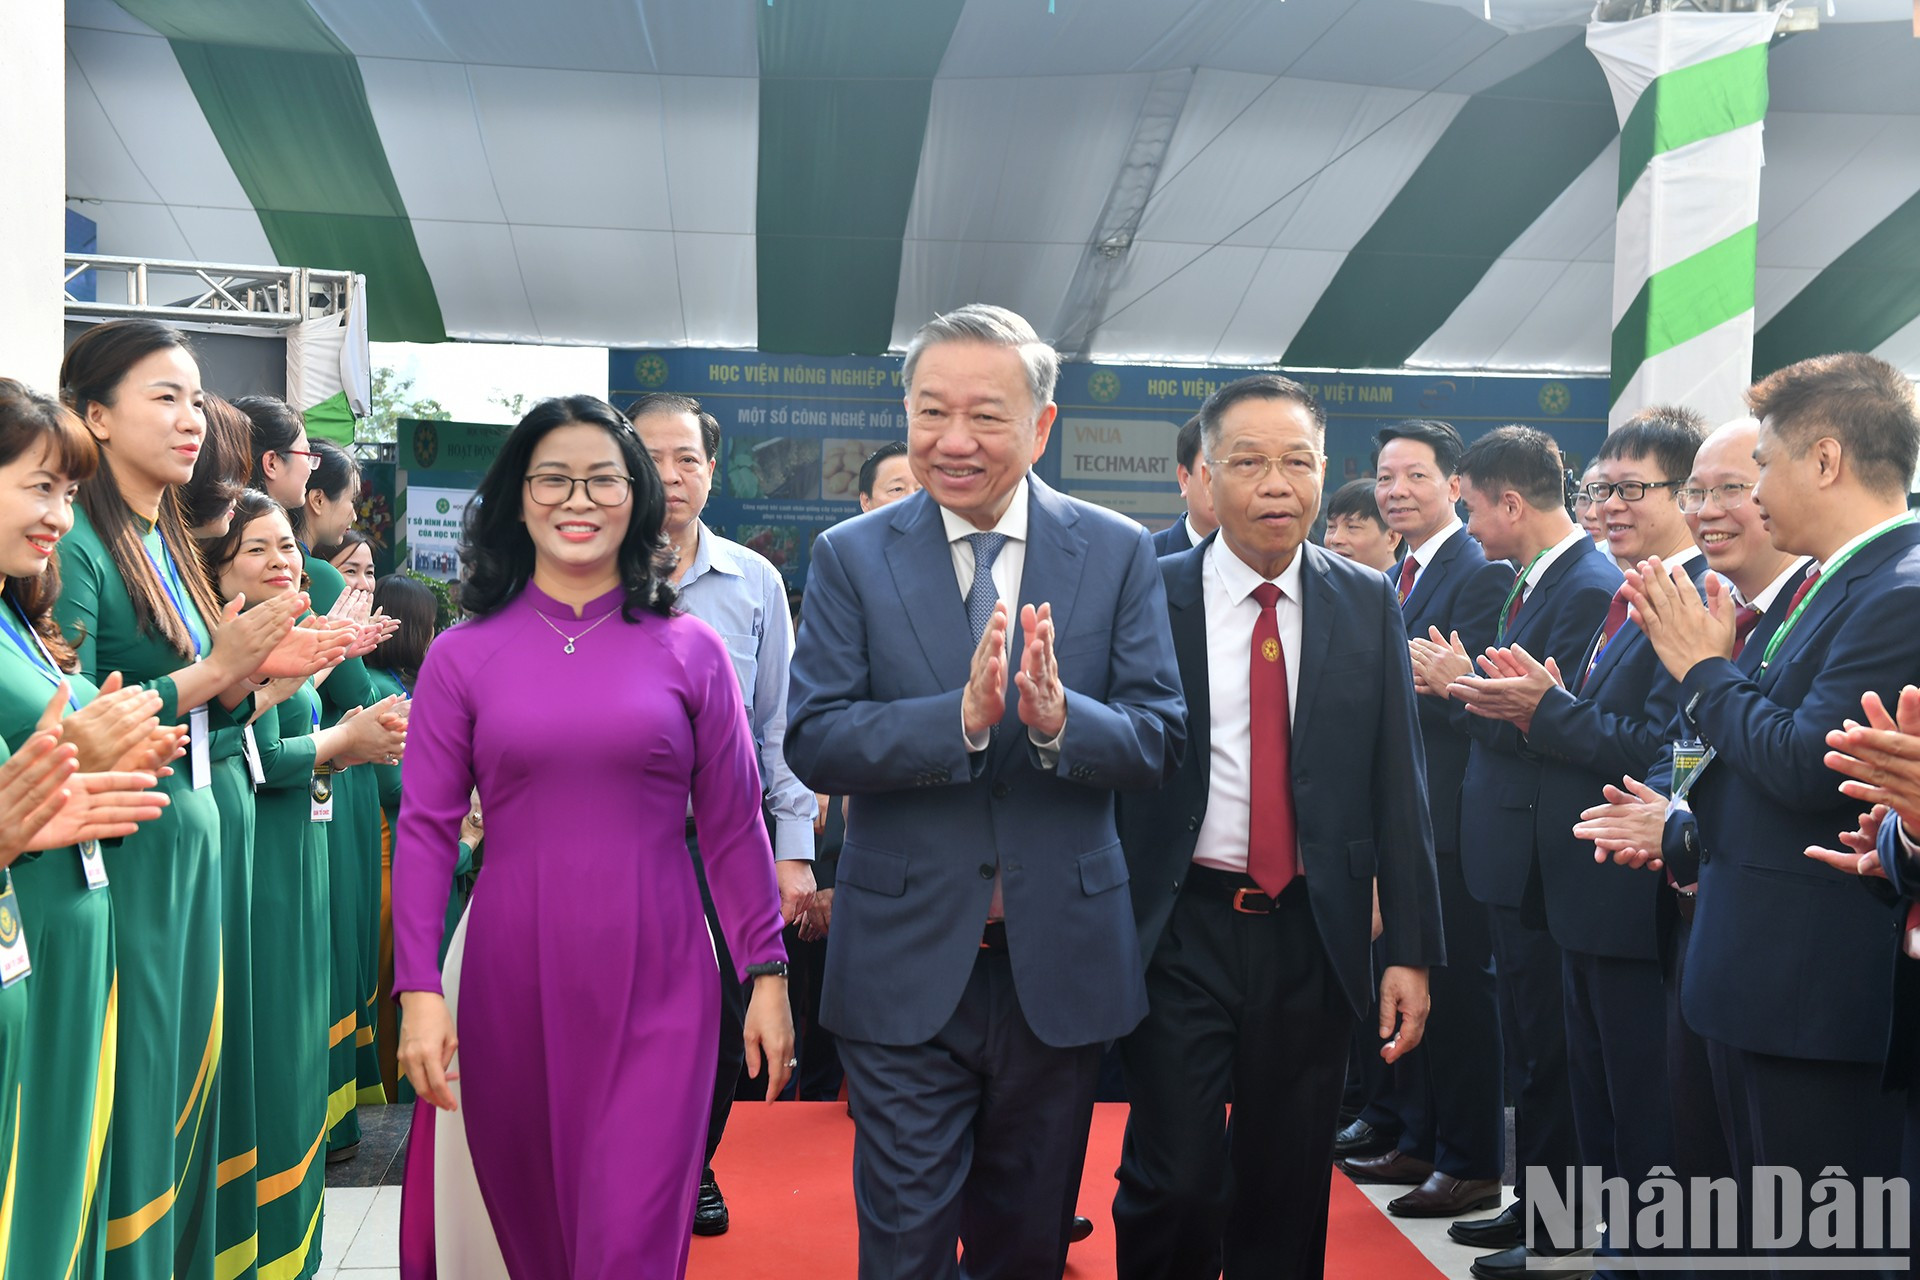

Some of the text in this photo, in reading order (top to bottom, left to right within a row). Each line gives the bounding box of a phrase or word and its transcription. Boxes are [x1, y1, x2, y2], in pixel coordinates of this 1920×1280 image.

[709, 364, 740, 384] HỌC
[744, 363, 779, 386] VIỆN
[783, 365, 826, 385] NÔNG
[831, 366, 886, 389] NGHIỆP
[1148, 379, 1178, 399] HỌC
[1182, 377, 1216, 400] VIỆN
[1323, 381, 1354, 404] VIỆT
[1358, 386, 1393, 403] NAM
[738, 406, 766, 426] MỘT
[770, 405, 788, 424] SỐ
[791, 408, 827, 426] CÔNG
[831, 409, 866, 430] NGHỆ
[869, 408, 892, 428] NỔI
[1074, 425, 1122, 444] VNUA
[1073, 454, 1169, 474] TECHMART
[424, 518, 441, 527] HÌNH
[418, 529, 432, 538] CỦA
[434, 530, 448, 539] HỌC
